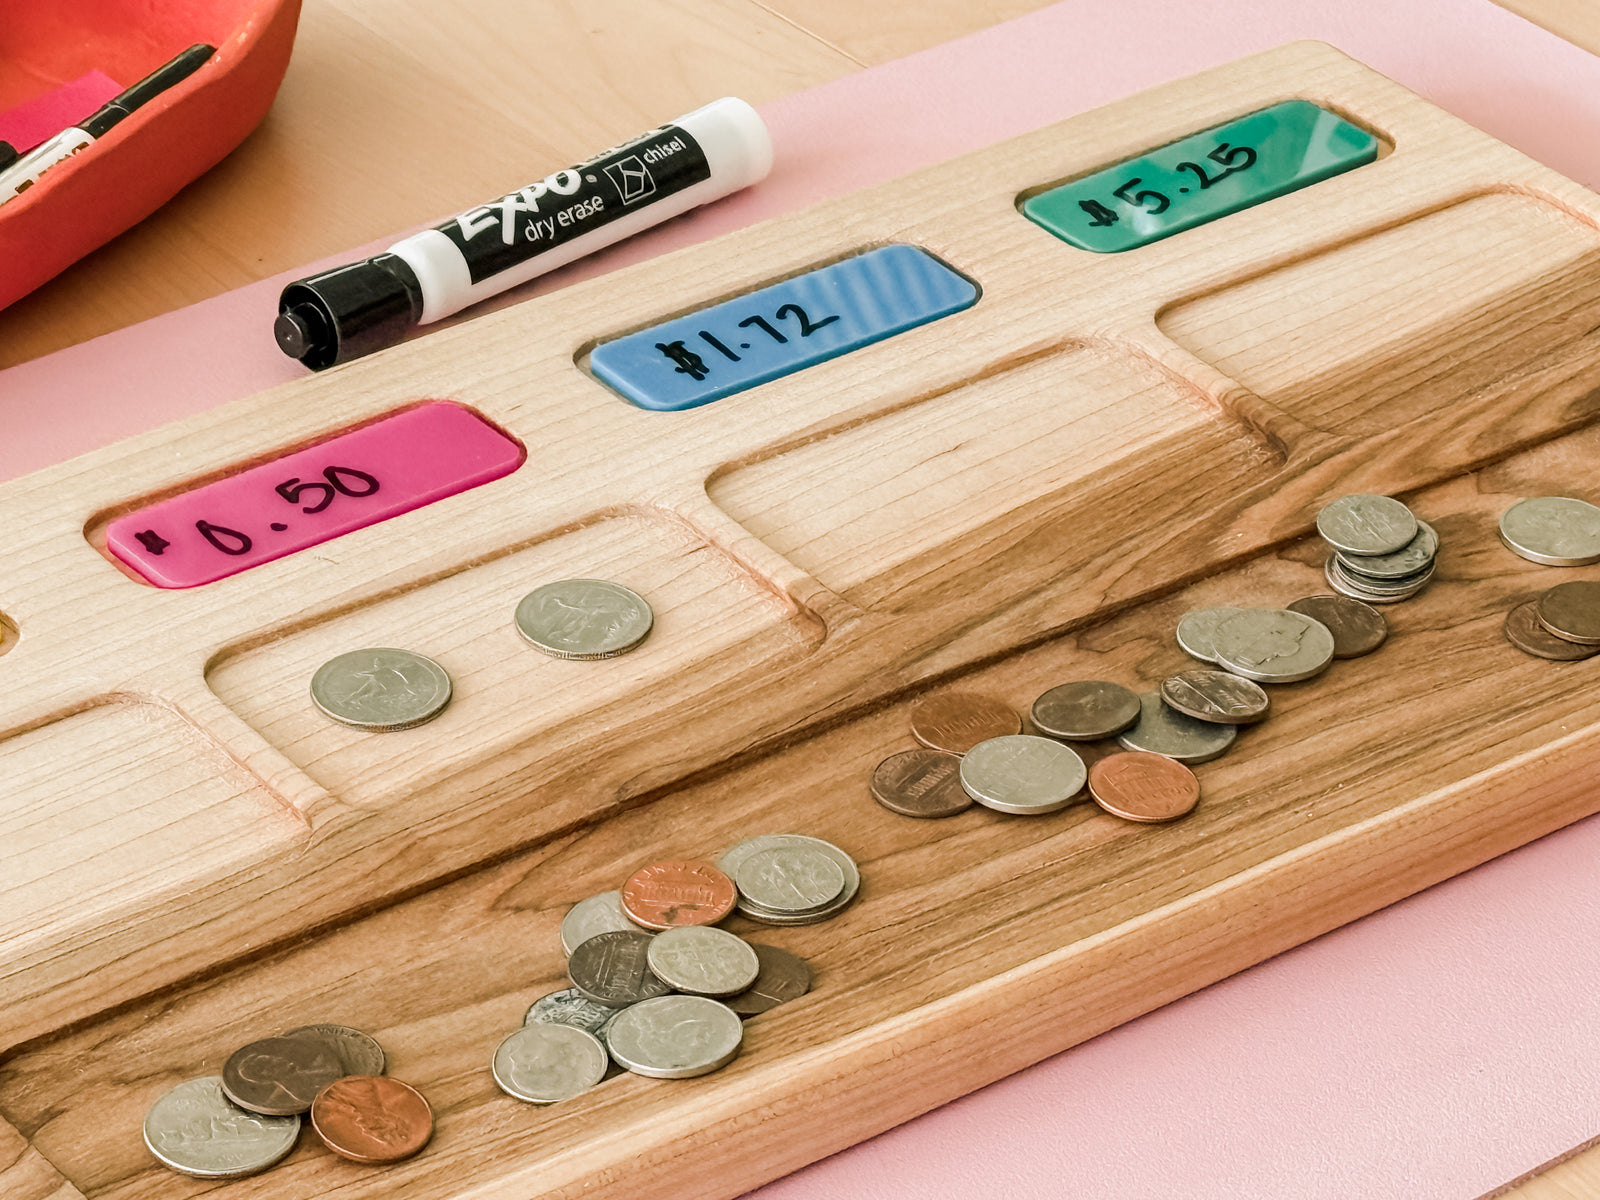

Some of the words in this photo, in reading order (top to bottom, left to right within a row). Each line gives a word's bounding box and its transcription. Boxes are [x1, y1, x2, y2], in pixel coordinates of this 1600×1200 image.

[643, 135, 687, 164] chisel
[1078, 142, 1257, 227] $5.25
[456, 169, 582, 245] EXPO
[524, 214, 556, 243] dry
[557, 195, 605, 228] erase
[655, 304, 840, 381] $1.72
